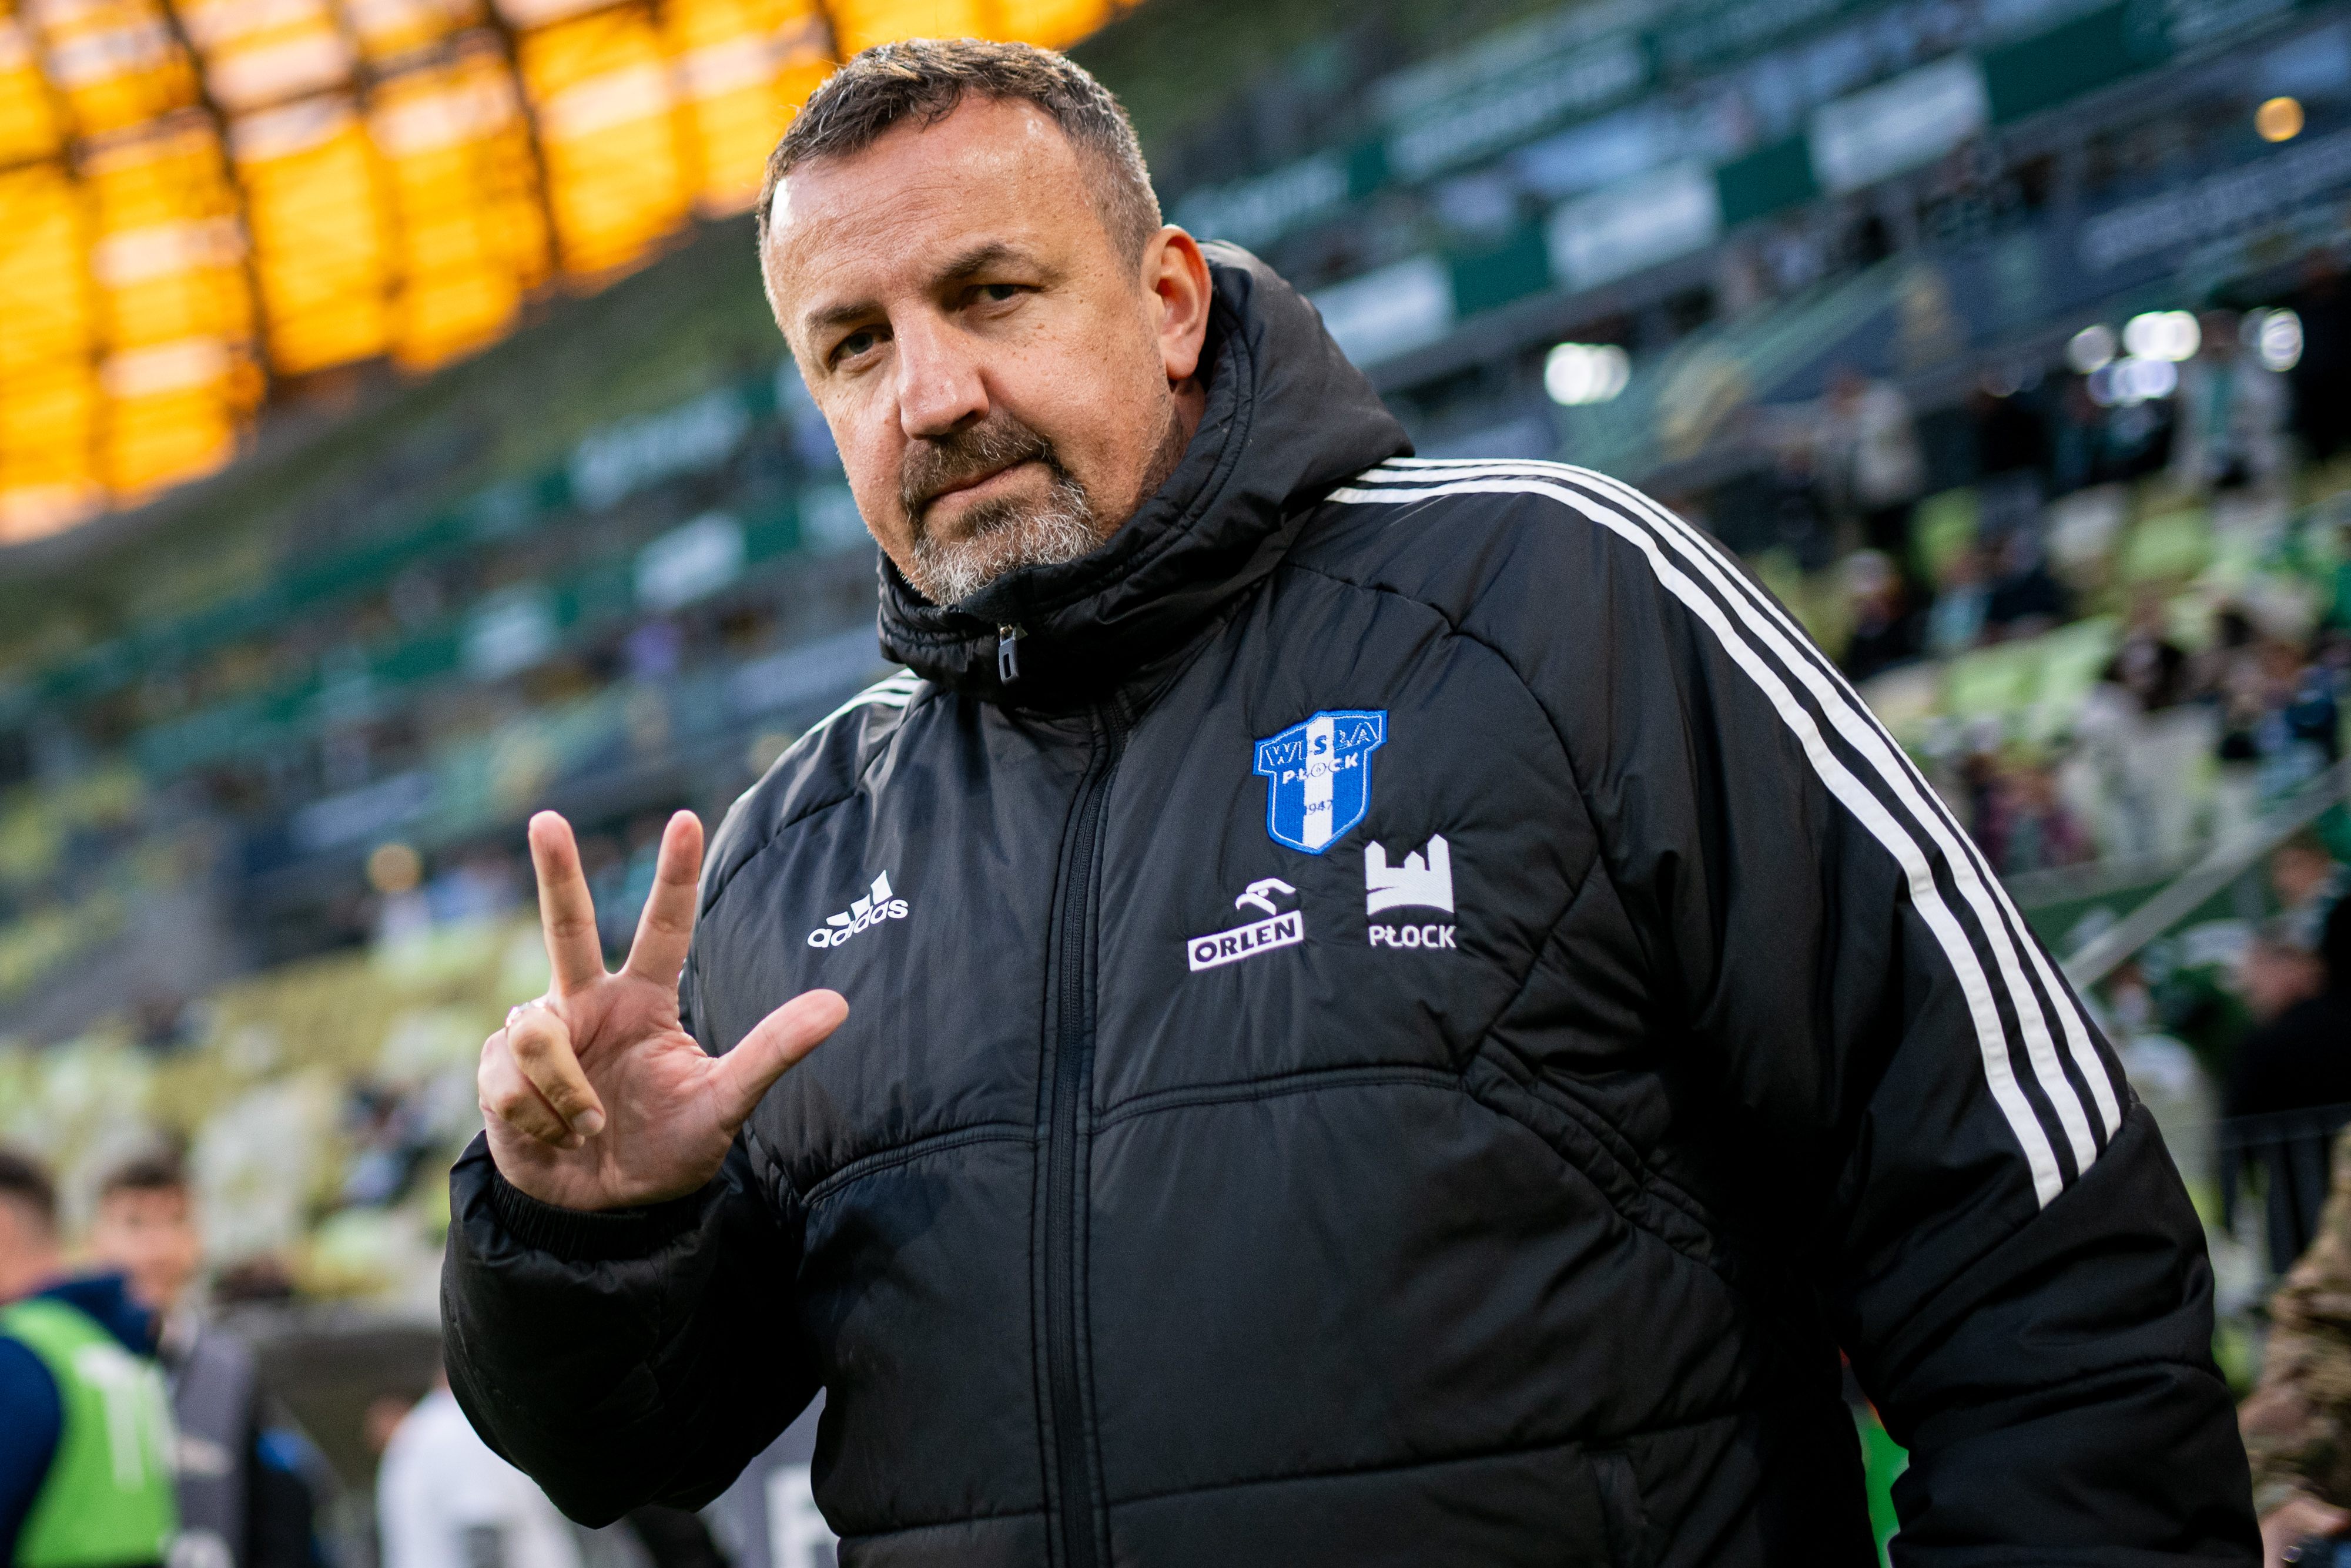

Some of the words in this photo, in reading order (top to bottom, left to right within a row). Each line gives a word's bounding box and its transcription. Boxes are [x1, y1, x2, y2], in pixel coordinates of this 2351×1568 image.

[1282, 752, 1358, 785] PŁOCK
[1304, 799, 1333, 816] 1947
[807, 899, 909, 948] adidas
[1194, 917, 1295, 963] ORLEN
[1368, 924, 1457, 949] PŁOCK
